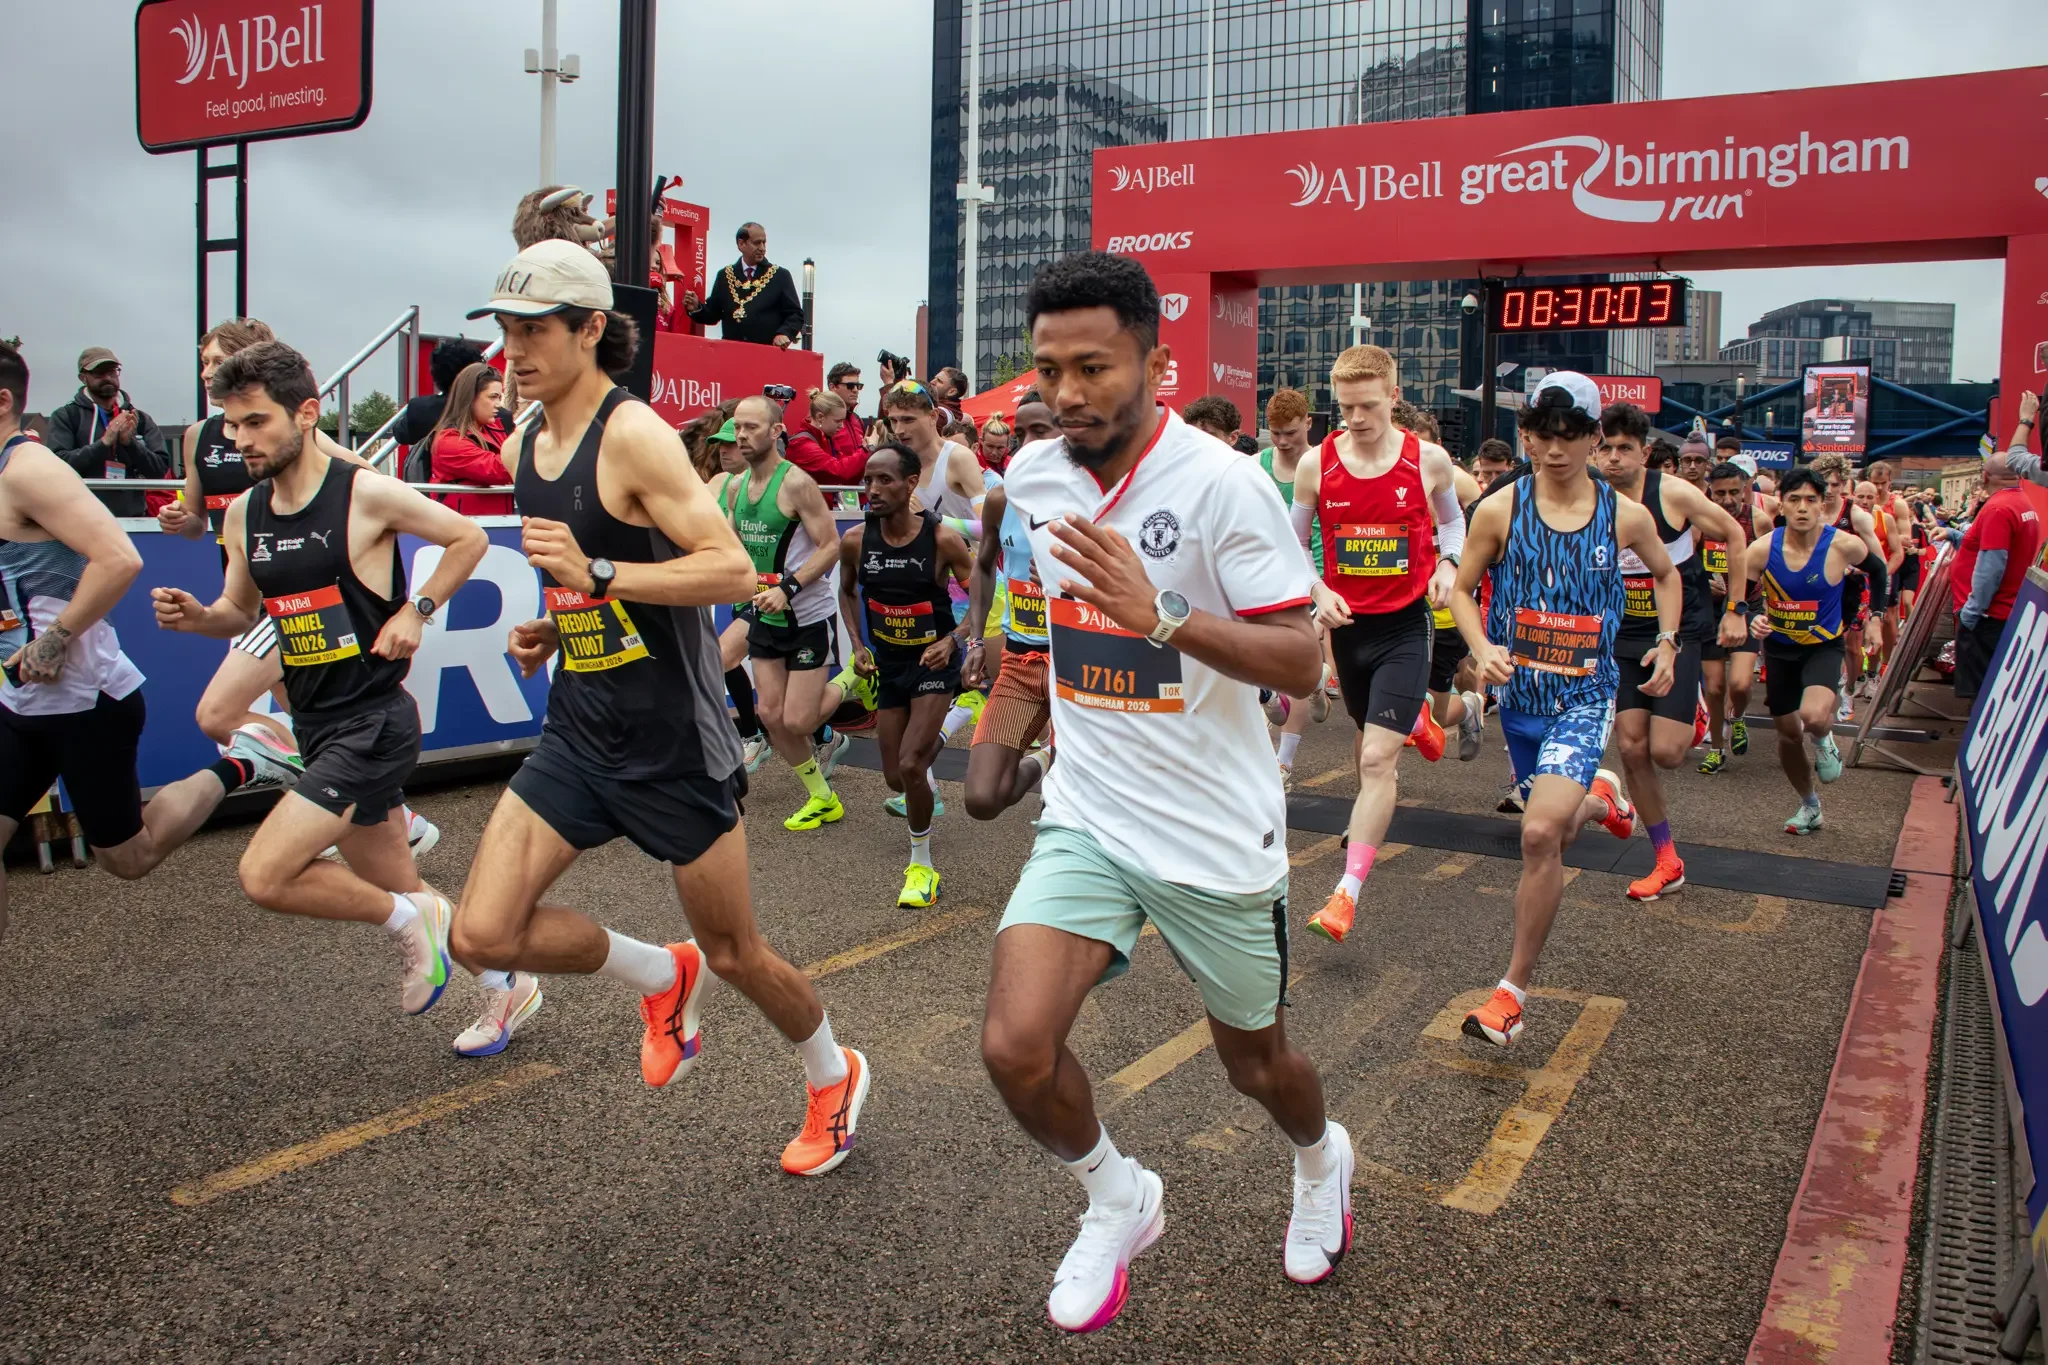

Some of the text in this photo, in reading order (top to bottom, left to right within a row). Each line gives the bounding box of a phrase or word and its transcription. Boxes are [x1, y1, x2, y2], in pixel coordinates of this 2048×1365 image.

[206, 86, 327, 119] Feel good, investing.
[1460, 131, 1909, 205] great birmingham
[671, 205, 701, 222] investing.
[1106, 231, 1194, 254] BROOKS
[1503, 285, 1672, 327] 08:30:03
[1226, 365, 1253, 380] Birmingham
[1815, 442, 1866, 452] Santander
[1740, 449, 1790, 462] ROOKS
[740, 520, 768, 533] Hayle
[1144, 511, 1178, 530] MANCHESTER
[1144, 546, 1171, 557] UNITED
[1345, 539, 1398, 552] BRYCHAN
[1363, 554, 1379, 567] 65
[1626, 590, 1651, 600] HILIP
[281, 613, 325, 635] DANIEL
[556, 609, 606, 634] FREDDIE
[885, 616, 915, 628] OMAR
[342, 636, 355, 645] 10K
[625, 635, 640, 647] 10K
[895, 628, 908, 639] 85
[1516, 625, 1598, 649] KA LONG THOMPSON
[289, 633, 327, 653] 11026
[569, 634, 604, 657] 11007
[606, 656, 623, 667] 2026
[1537, 646, 1574, 664] 11201
[918, 680, 945, 691] HOKA
[1082, 664, 1136, 694] 17161
[1163, 687, 1180, 696] 10K
[1074, 692, 1150, 712] BIRMINGHAM 2026
